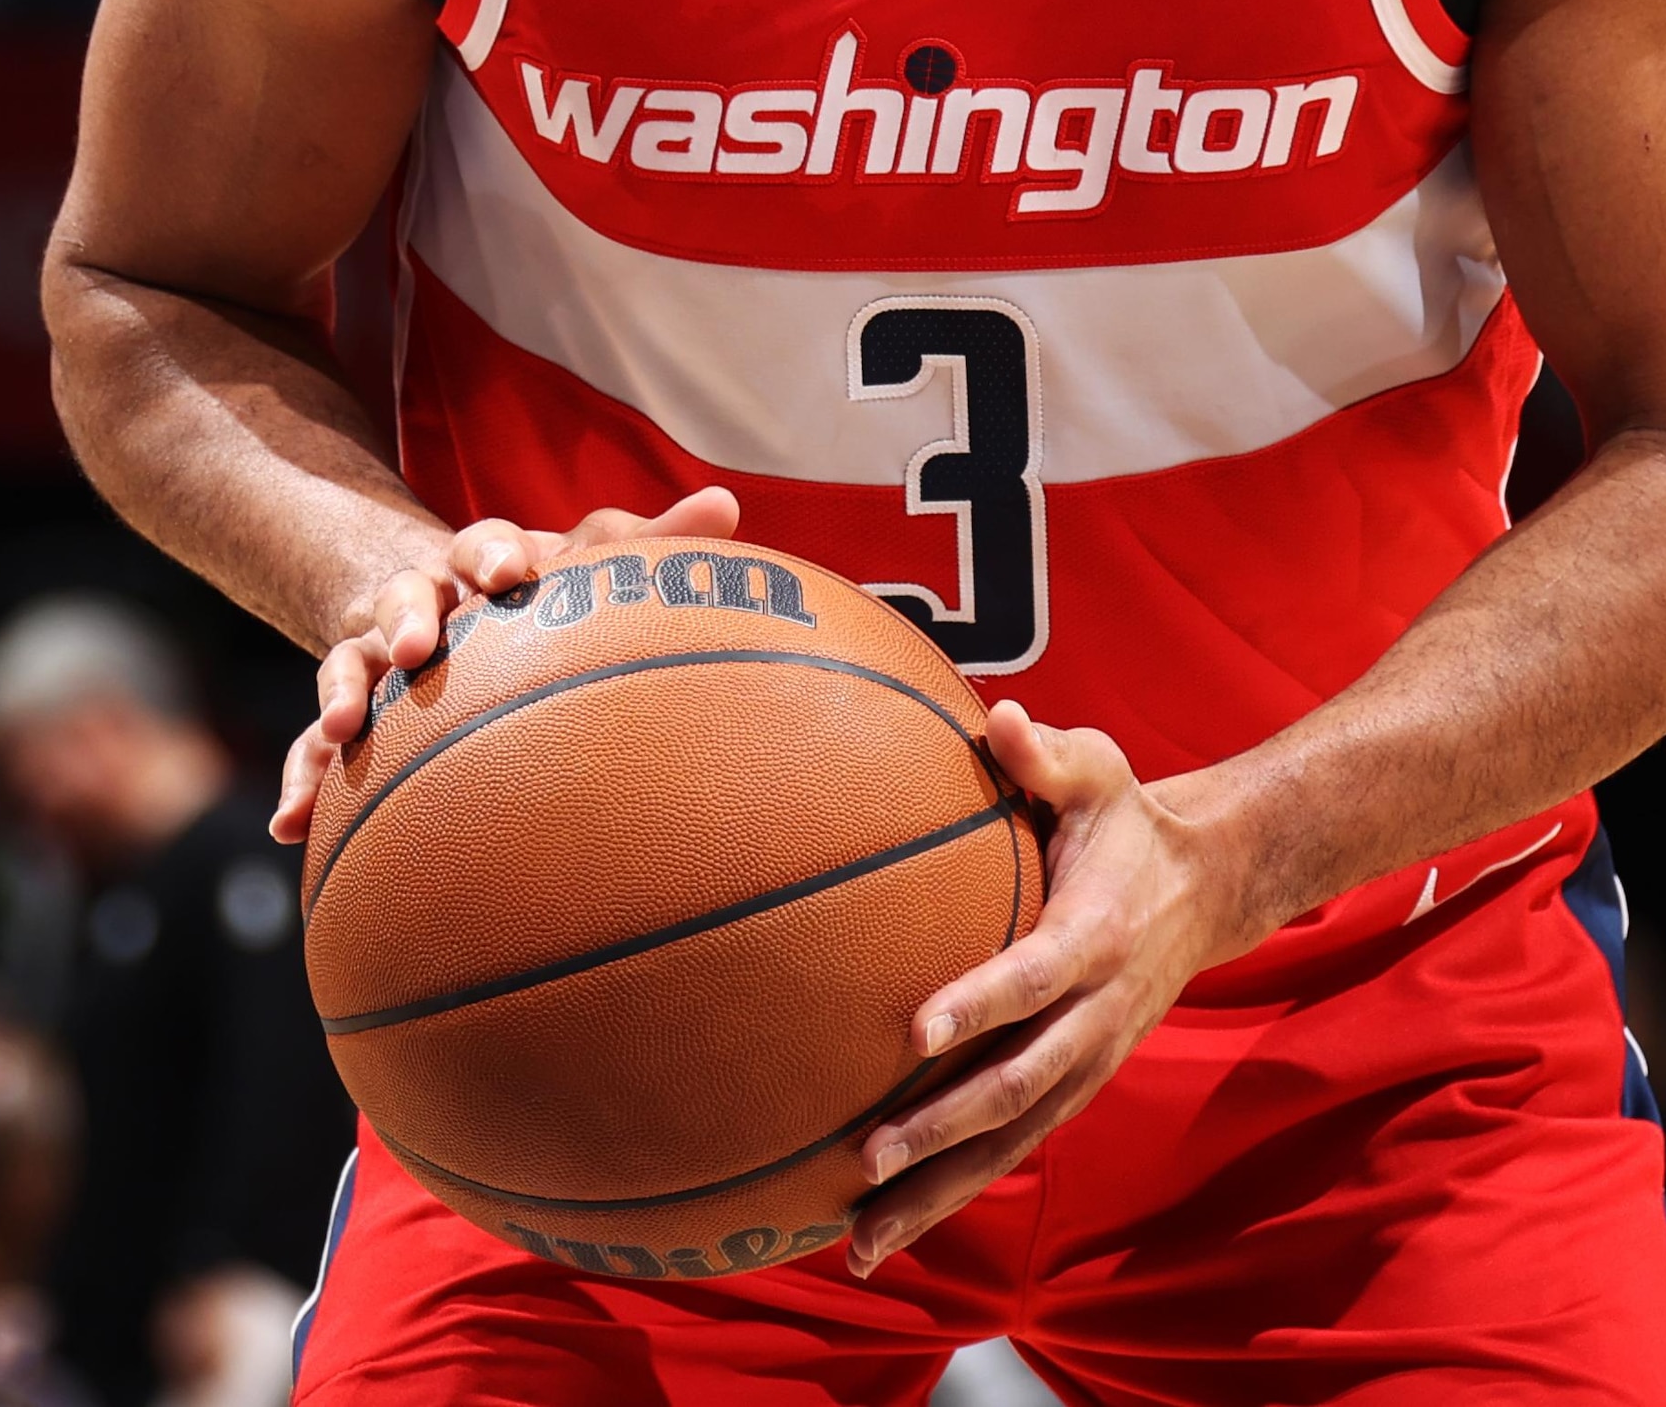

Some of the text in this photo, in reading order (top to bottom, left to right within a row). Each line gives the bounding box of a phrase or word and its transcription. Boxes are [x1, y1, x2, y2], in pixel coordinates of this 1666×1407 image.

[519, 30, 1360, 214] washington
[846, 295, 1050, 676] 3
[361, 550, 817, 742] Wils
[503, 1206, 869, 1278] Wils
